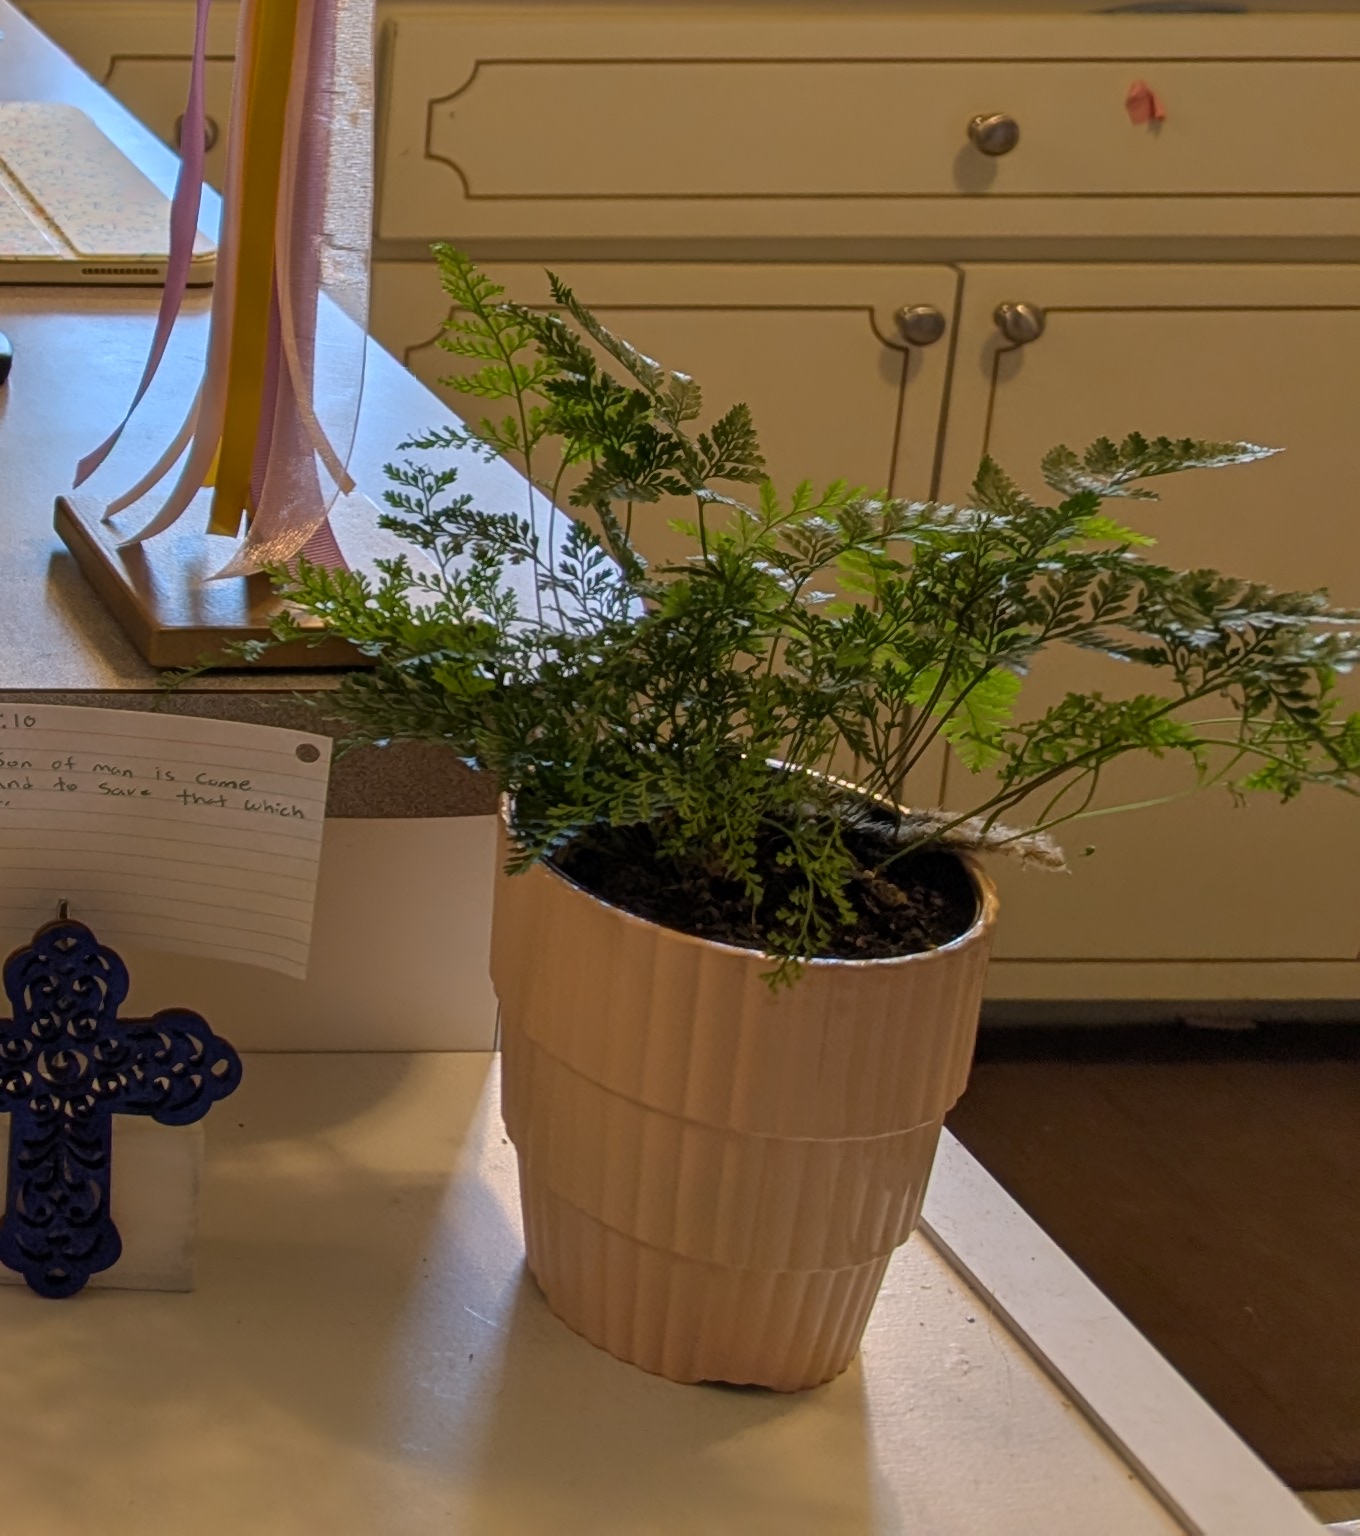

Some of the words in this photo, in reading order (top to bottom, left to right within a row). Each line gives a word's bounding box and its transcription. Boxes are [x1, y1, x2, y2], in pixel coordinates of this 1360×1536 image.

[51, 755, 76, 770] of
[92, 763, 134, 779] man
[155, 766, 176, 782] is
[53, 776, 79, 792] to
[176, 788, 229, 808] that
[244, 798, 306, 820] which
